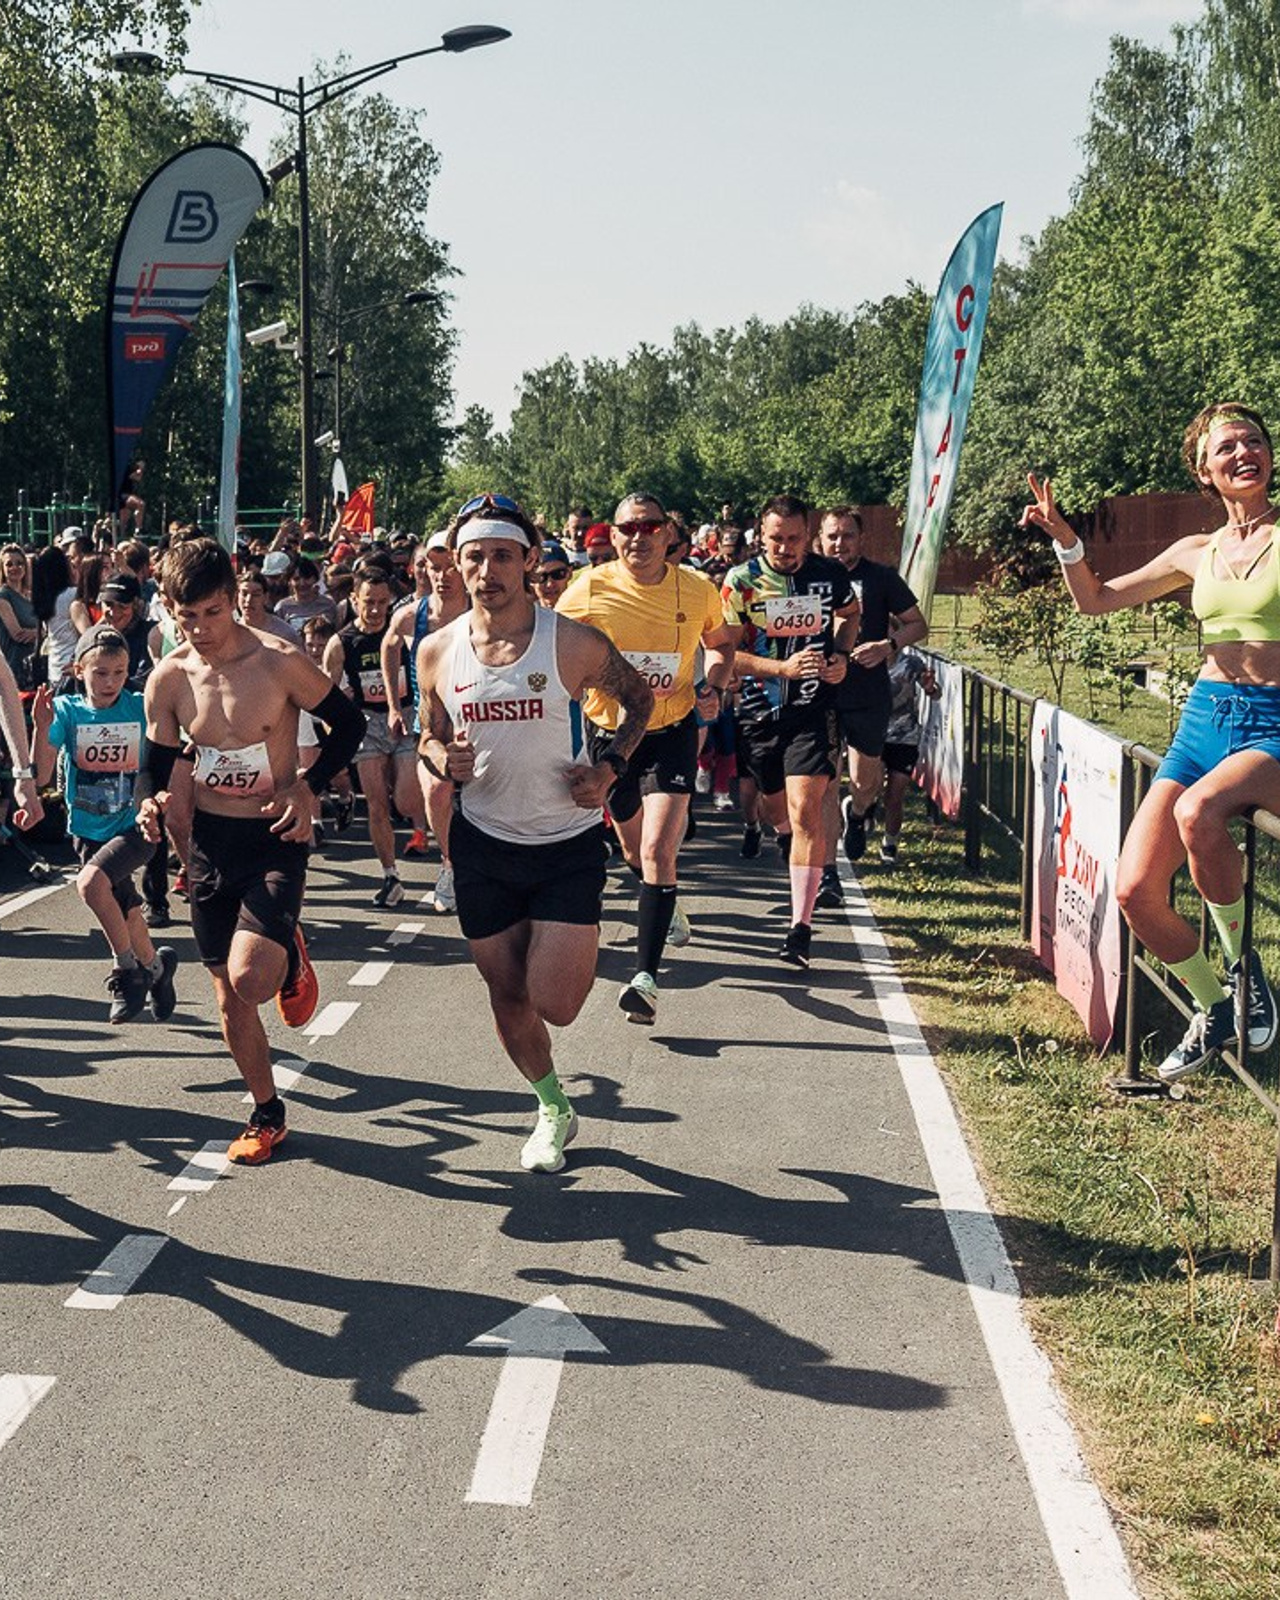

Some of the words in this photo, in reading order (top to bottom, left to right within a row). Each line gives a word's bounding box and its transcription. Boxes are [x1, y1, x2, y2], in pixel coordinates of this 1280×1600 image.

[774, 613, 815, 631] 0430
[369, 684, 386, 696] 02
[641, 673, 673, 689] 00
[462, 699, 543, 723] RUSSIA
[85, 745, 129, 763] 0531
[205, 770, 260, 789] 0457
